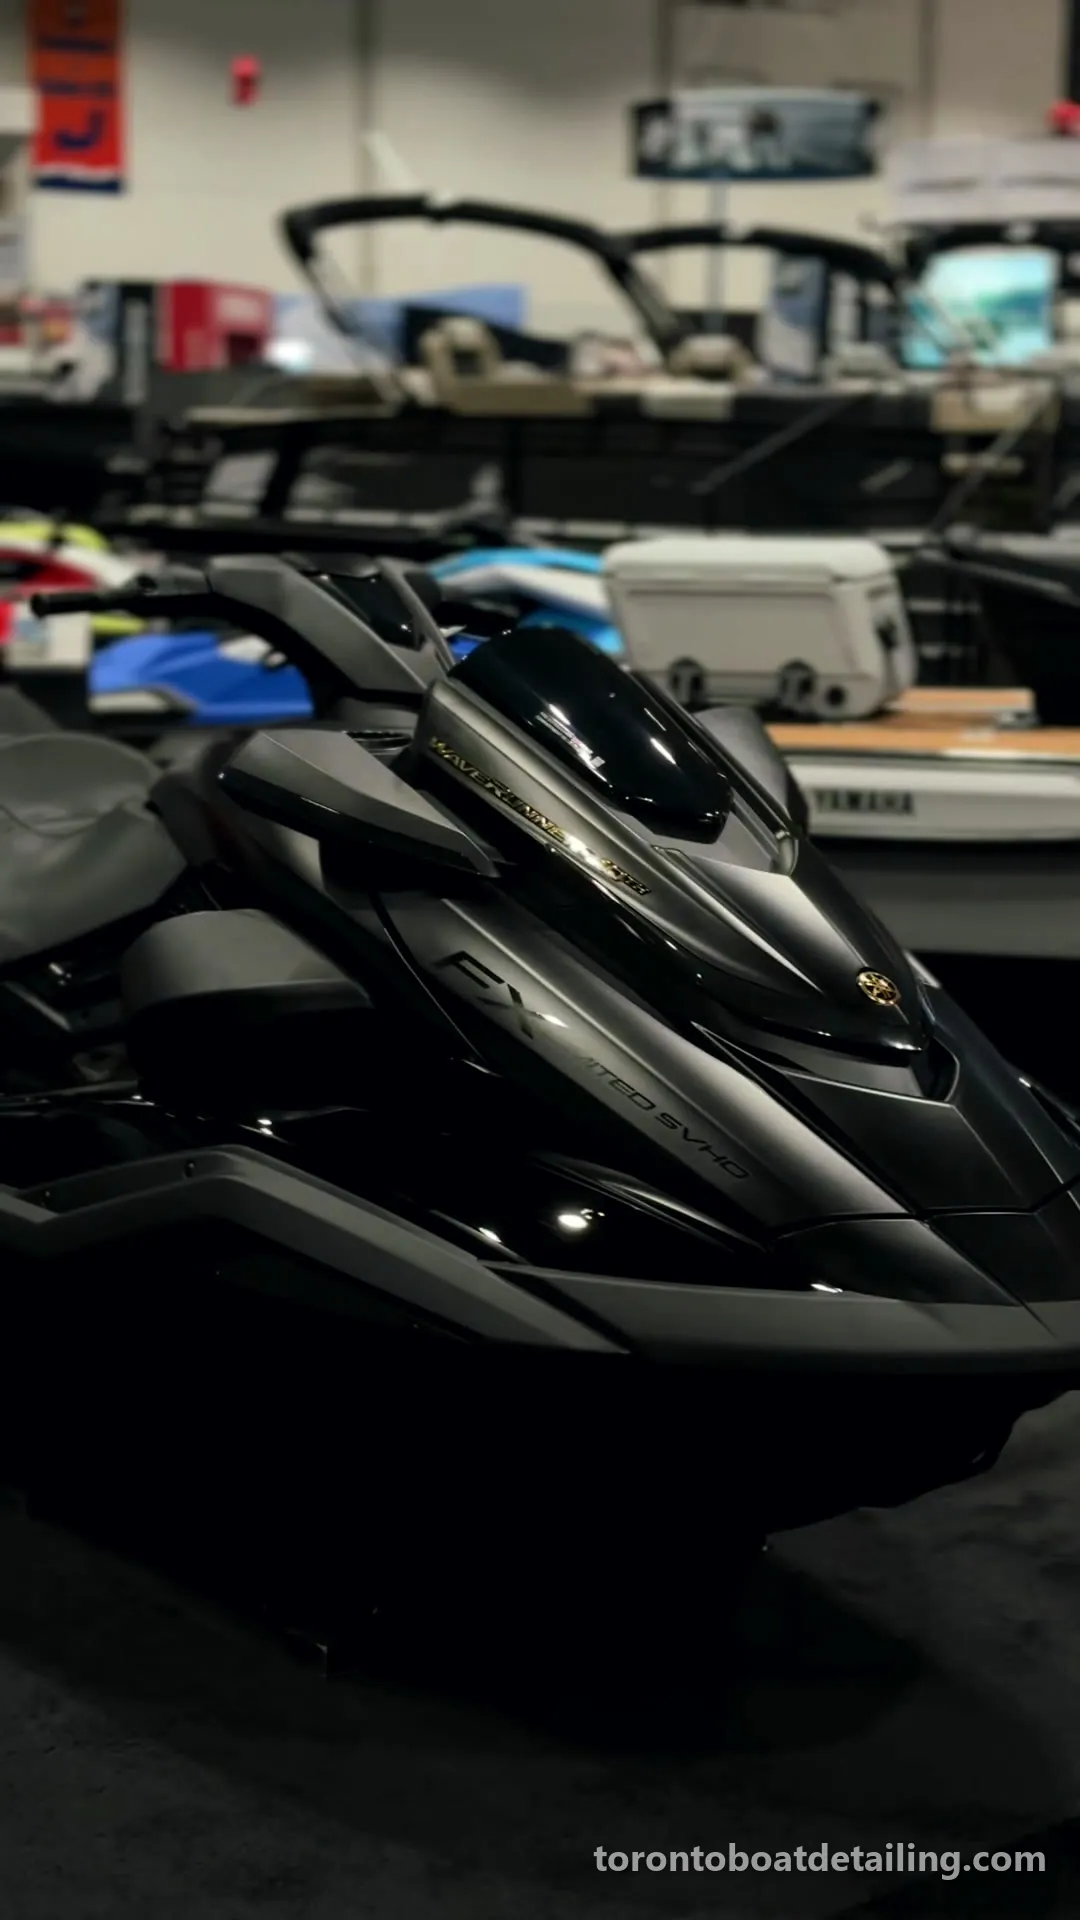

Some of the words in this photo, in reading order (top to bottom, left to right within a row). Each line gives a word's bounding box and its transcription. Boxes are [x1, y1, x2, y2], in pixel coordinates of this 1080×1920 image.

[429, 736, 588, 858] WAVERUNNE
[432, 950, 568, 1039] FX
[654, 1112, 750, 1179] SVHO
